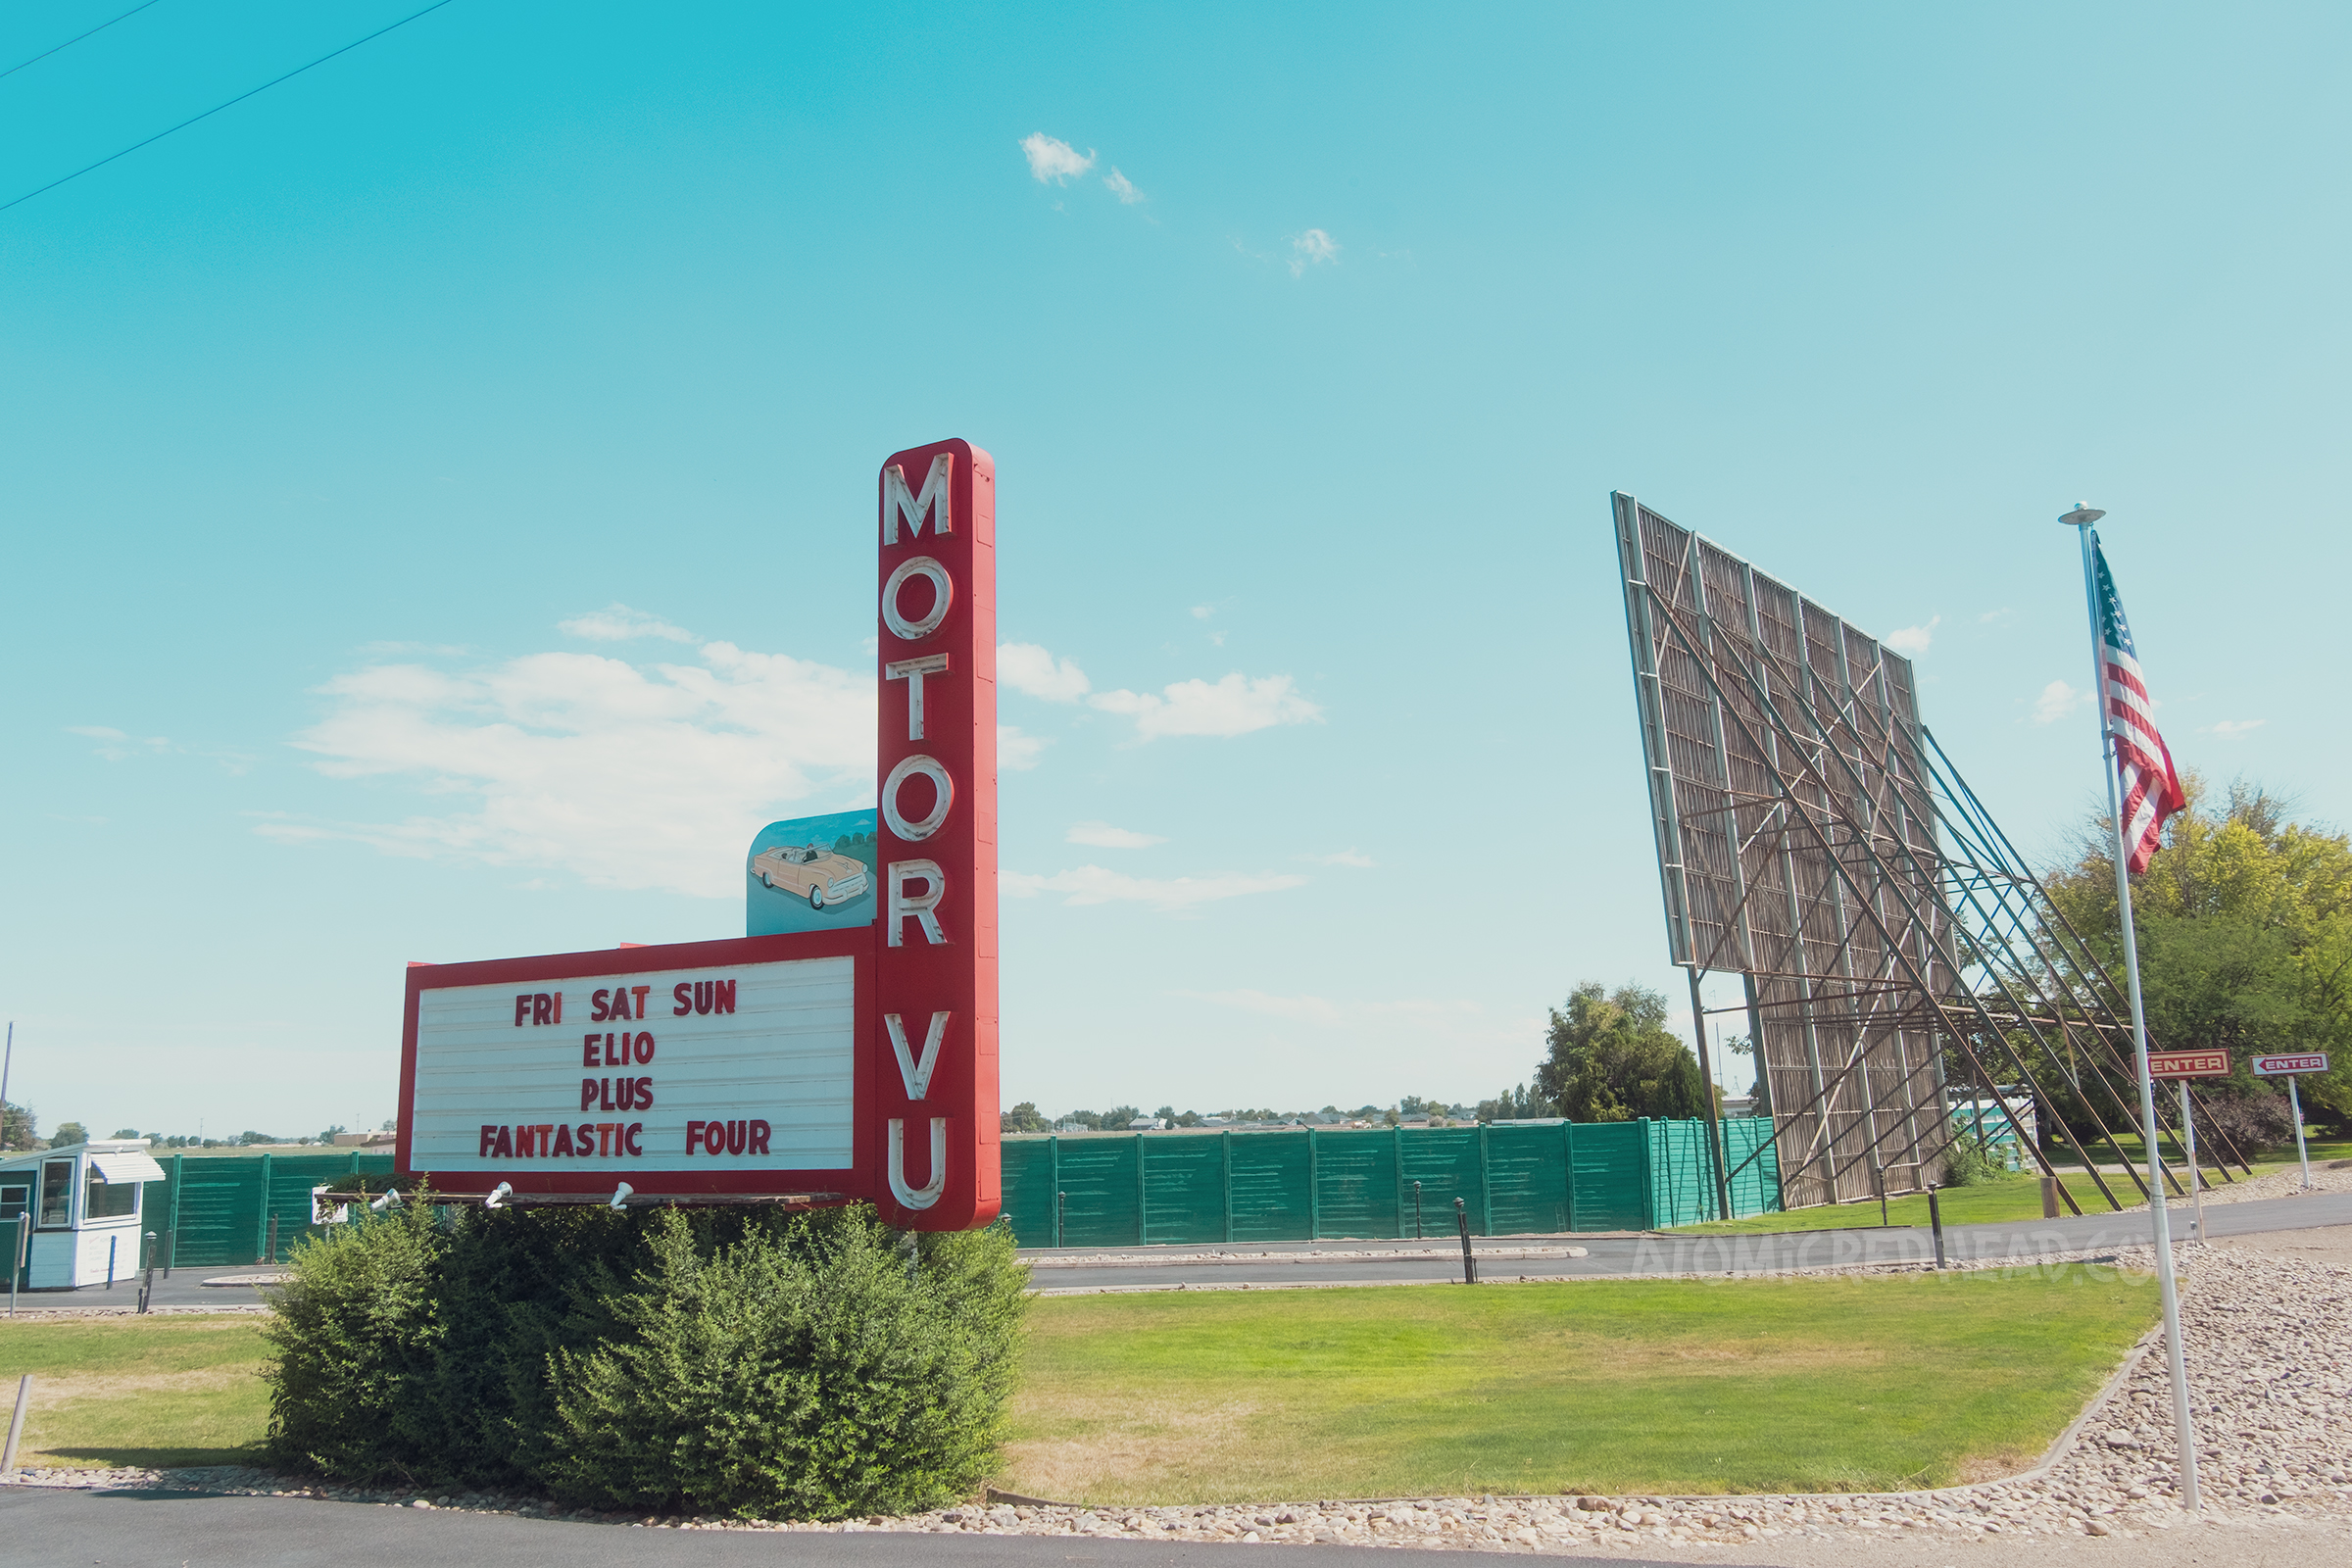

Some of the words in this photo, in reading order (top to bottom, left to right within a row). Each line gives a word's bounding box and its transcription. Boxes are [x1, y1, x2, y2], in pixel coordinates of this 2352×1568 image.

[882, 452, 956, 947] MOTOR
[514, 992, 562, 1026] FRI
[591, 985, 651, 1022] SAT
[673, 979, 736, 1016] SUN
[583, 1032, 655, 1067] ELIO
[2150, 1057, 2223, 1072] ENTER
[2265, 1058, 2322, 1070] ENTER
[580, 1076, 654, 1111] PLUS
[884, 1011, 952, 1210] VU
[479, 1123, 643, 1157] FANTASTIC
[686, 1119, 771, 1155] FOUR
